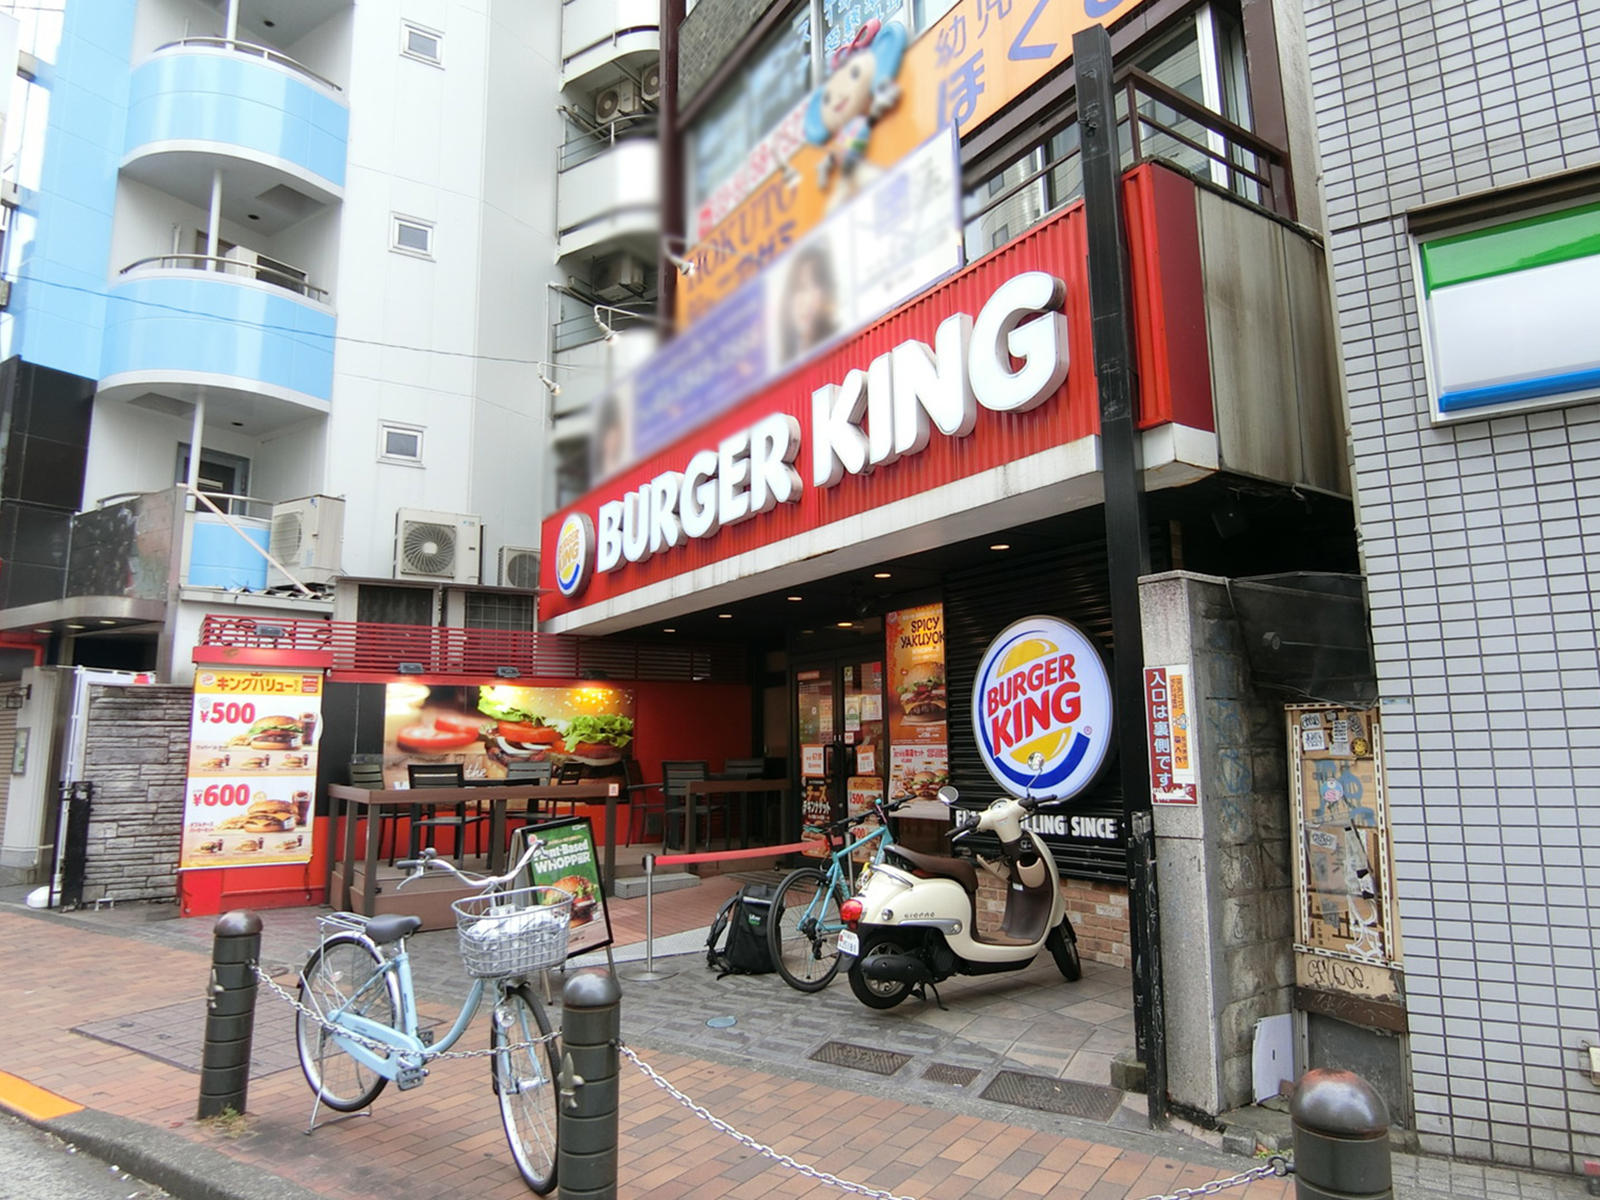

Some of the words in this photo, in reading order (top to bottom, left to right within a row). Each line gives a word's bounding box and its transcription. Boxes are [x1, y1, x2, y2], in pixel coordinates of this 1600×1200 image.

[597, 410, 803, 573] BURGER
[812, 270, 1069, 488] KING
[911, 616, 940, 633] SPICY
[216, 676, 294, 692] キングバリュー
[987, 653, 1076, 718] BURGER
[200, 702, 256, 724] ¥500
[991, 681, 1081, 757] KING
[1150, 671, 1173, 788] 入口は裏側です
[465, 763, 488, 778] the
[193, 783, 250, 806] ¥600
[1070, 816, 1118, 839] SINCE
[534, 852, 591, 874] WHOPPER
